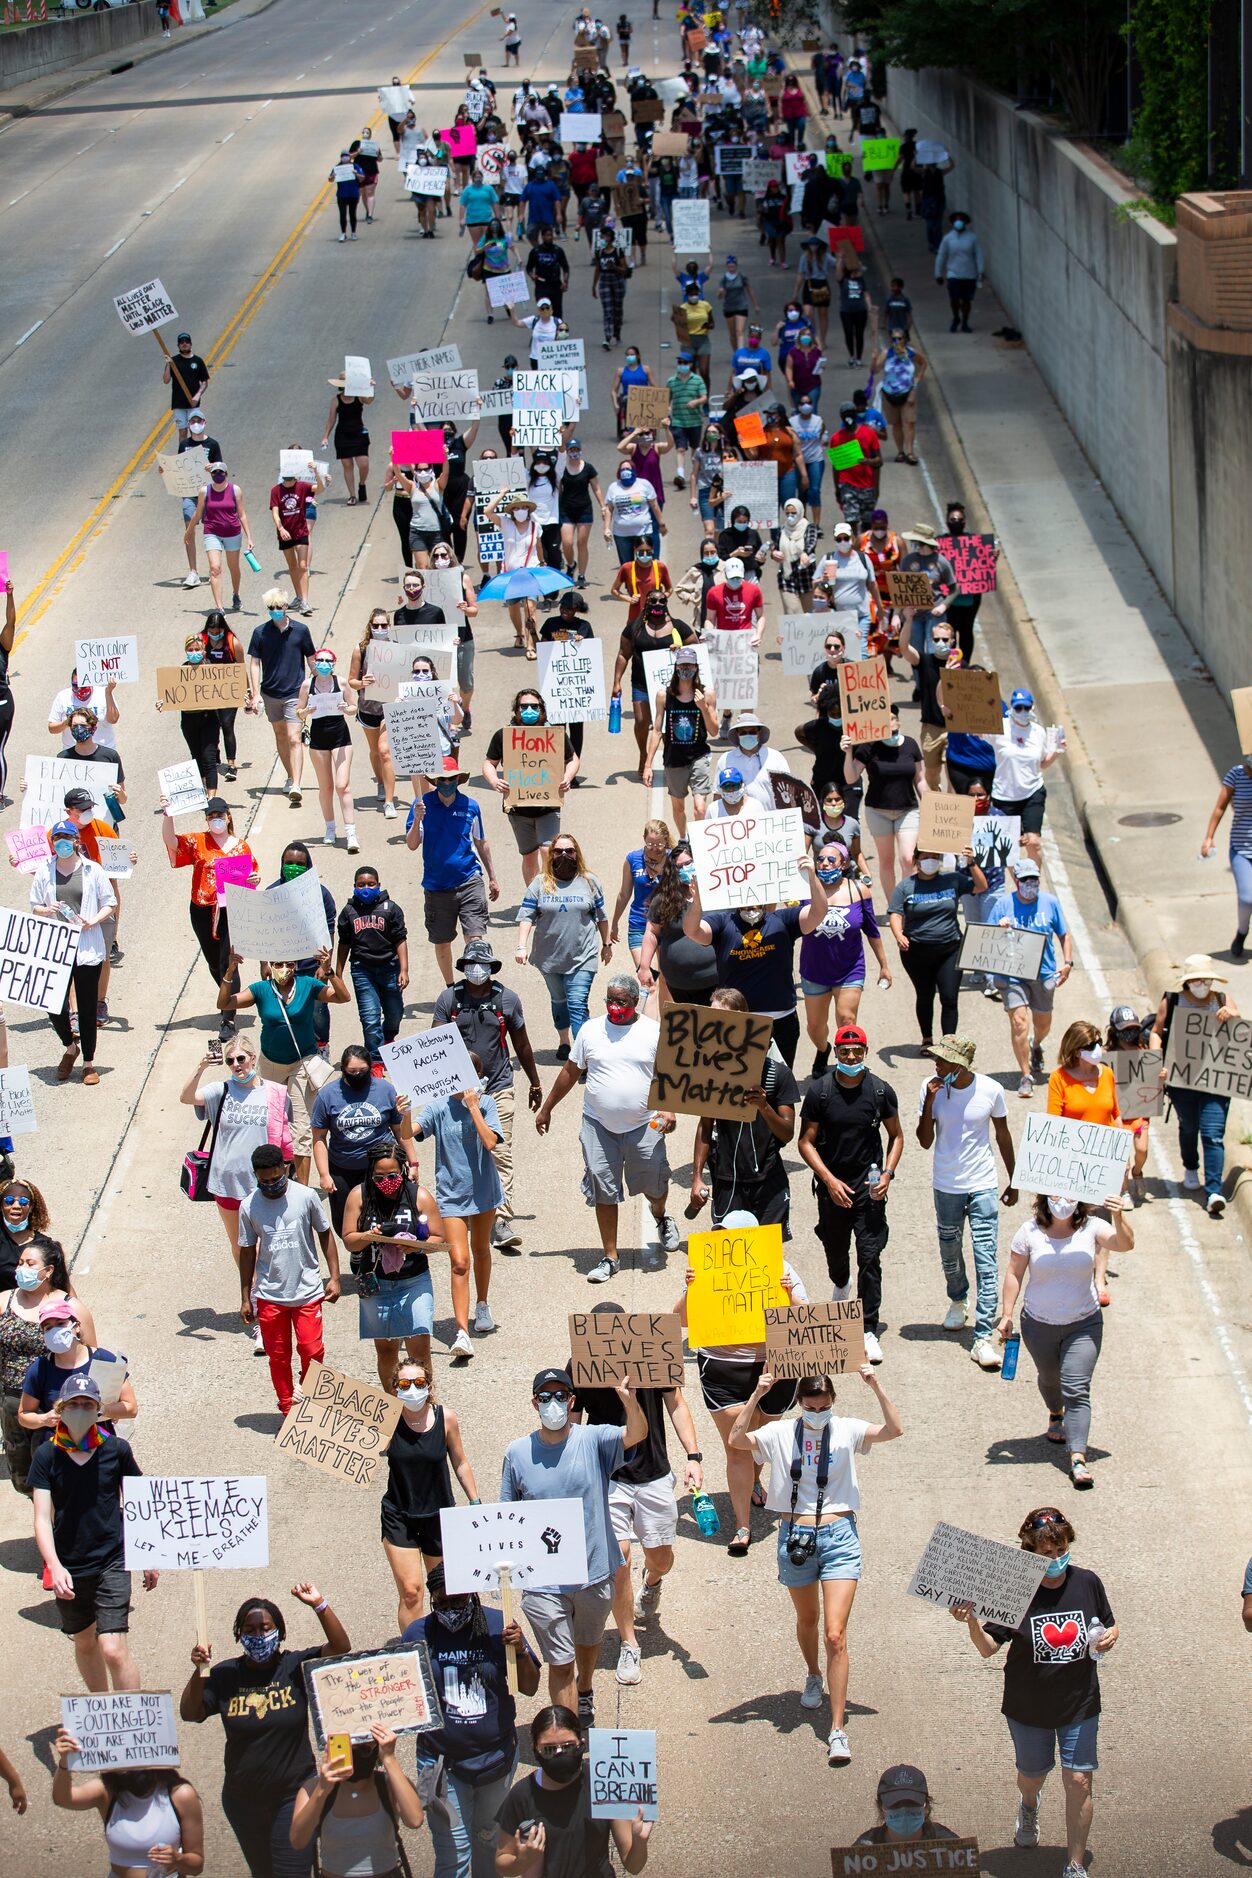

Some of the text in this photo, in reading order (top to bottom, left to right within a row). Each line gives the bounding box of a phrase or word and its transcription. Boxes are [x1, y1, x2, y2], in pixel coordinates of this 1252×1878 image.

[121, 294, 151, 314] MATTER
[127, 290, 143, 302] LIVES
[142, 298, 165, 314] BLACK
[144, 304, 174, 326] MATTER
[556, 344, 578, 352] LIVES
[431, 350, 456, 368] NAMES
[416, 374, 477, 392] SILENCE
[516, 374, 556, 391] BLACK
[517, 392, 557, 408] TRANS
[416, 400, 478, 418] VIOLENCE
[640, 404, 655, 418] IS
[518, 410, 556, 428] LIVES
[513, 428, 560, 444] MATTER
[958, 534, 982, 548] THE
[892, 574, 924, 584] BLACK
[900, 584, 928, 594] LIVES
[894, 593, 934, 606] MATTER
[78, 642, 105, 658] Skin
[561, 640, 578, 658] IS
[88, 657, 120, 672] is NOT
[552, 660, 570, 673] HER
[82, 674, 91, 686] A
[180, 666, 241, 682] NO JUSTICE
[556, 676, 587, 686] WORTH
[844, 664, 886, 692] Black
[164, 682, 240, 704] NO PEACE
[551, 686, 594, 698] LESS THAN
[560, 696, 592, 709] MINE?
[846, 694, 886, 714] Lives
[846, 720, 889, 741] Matter
[512, 728, 556, 754] Honk
[520, 753, 548, 768] for
[41, 762, 95, 782] BLACK
[163, 766, 194, 783] Black
[508, 768, 552, 788] Black
[168, 779, 195, 795] Lives
[518, 788, 550, 800] Lives
[169, 790, 204, 808] Matter
[934, 802, 961, 811] Black
[57, 822, 66, 830] A
[934, 814, 959, 825] Lives
[704, 814, 797, 852] STOP THE
[932, 828, 962, 838] MATTER
[12, 832, 45, 852] Black
[99, 840, 128, 851] Silence
[16, 847, 47, 861] Lives
[110, 852, 118, 862] is
[711, 838, 793, 867] VIOLENCE
[218, 863, 248, 875] Silence
[709, 859, 799, 890] STOP THE
[728, 880, 791, 905] HATE
[354, 915, 384, 934] BULLS
[0, 914, 80, 967] JUSTICE
[730, 944, 776, 956] SHOWCASE
[739, 952, 766, 960] CAMP
[972, 955, 1026, 974] MATTER
[0, 958, 58, 1009] PEACE
[664, 1009, 770, 1056] Black
[1186, 1013, 1252, 1048] BLAC
[414, 1050, 448, 1070] RACISM
[676, 1045, 748, 1075] Lives
[413, 1074, 462, 1096] PATRIOTISM
[433, 1086, 458, 1098] #BLM
[9, 1090, 30, 1100] Black
[8, 1100, 32, 1110] Lives
[226, 1102, 268, 1115] RACISM
[227, 1113, 267, 1127] SUCKS
[337, 1116, 382, 1128] MAVERICKS
[1027, 1117, 1132, 1162] White SILENCE
[1028, 1152, 1108, 1186] VIOLENCE
[1069, 1180, 1100, 1196] Matter
[268, 1240, 300, 1252] adidas
[704, 1238, 757, 1270] BLACK
[713, 1265, 770, 1292] LIVES
[764, 1300, 862, 1326] BLACK LIVES
[574, 1314, 664, 1336] BLACK
[590, 1340, 674, 1362] LIVES
[768, 1344, 848, 1363] Matter is the
[577, 1362, 683, 1386] MATTER
[774, 1358, 846, 1378] MINIMUM!
[76, 1378, 88, 1390] T
[313, 1370, 390, 1424] BLACK
[296, 1396, 380, 1450] LIVES
[806, 1440, 822, 1452] BE
[280, 1426, 376, 1484] MATTER
[150, 1480, 240, 1500] WHITE
[124, 1498, 262, 1522] SUPREMACY
[472, 1512, 525, 1528] BLACK
[160, 1518, 232, 1540] KILLS
[934, 1530, 952, 1540] JUAN
[134, 1538, 200, 1566] LET ME
[480, 1541, 523, 1552] LIVES
[940, 1575, 966, 1588] JORDAN
[944, 1566, 1032, 1600] CHRISTIAN BOTHAM
[915, 1584, 1017, 1625] SAY NAMES
[438, 1650, 468, 1660] MAIN
[322, 1674, 344, 1686] The
[346, 1681, 361, 1692] the
[360, 1680, 416, 1700] STRONGER
[68, 1696, 160, 1712] IF YOU ARE NOT
[332, 1707, 354, 1718] Than
[360, 1703, 373, 1711] the
[84, 1708, 156, 1732] OUTRAGED
[78, 1732, 157, 1748] YOU ARE NOT
[611, 1736, 628, 1759] I
[126, 1745, 179, 1760] ATTENTION
[594, 1780, 657, 1801] BREATHE
[844, 1848, 976, 1874] NO JUSTICE
